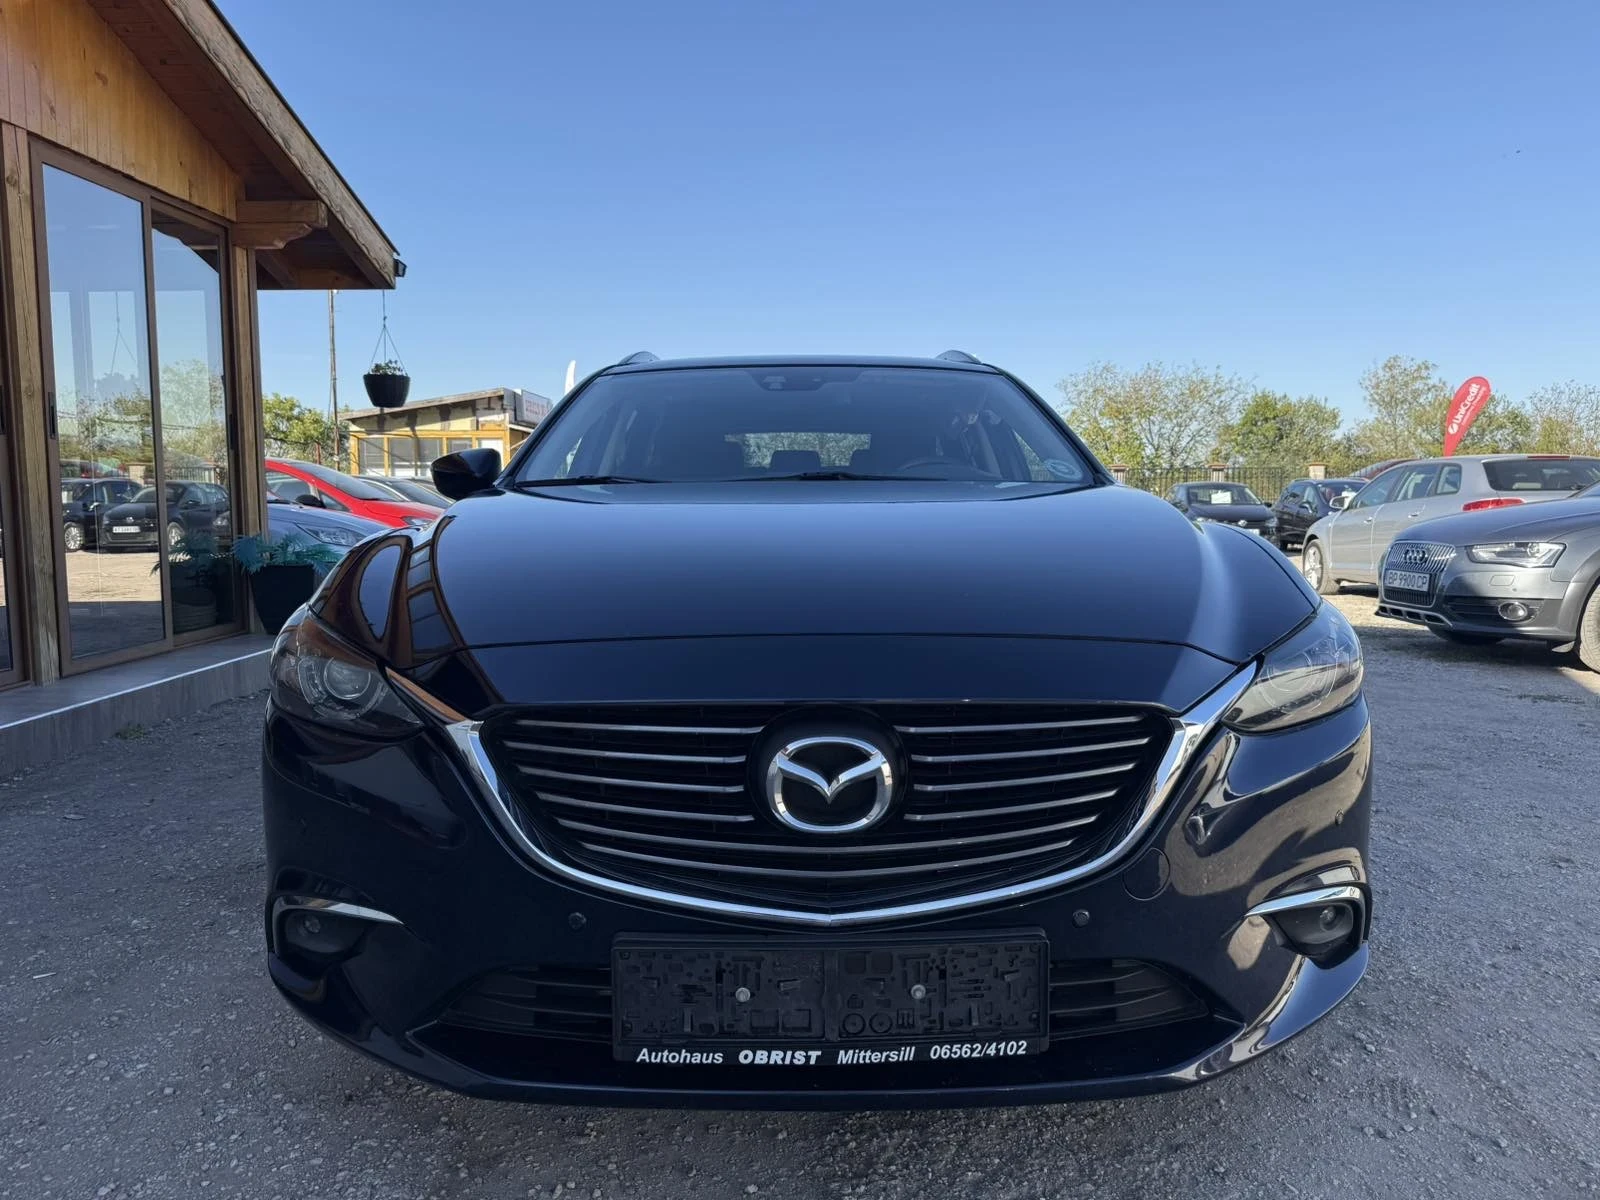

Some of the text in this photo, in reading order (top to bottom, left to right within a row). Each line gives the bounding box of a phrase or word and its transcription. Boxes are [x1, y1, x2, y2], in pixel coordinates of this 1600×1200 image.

[1452, 383, 1481, 424] UniCredit
[636, 1040, 1028, 1065] Autohaus OBRIST Mittersill 06562/4102
